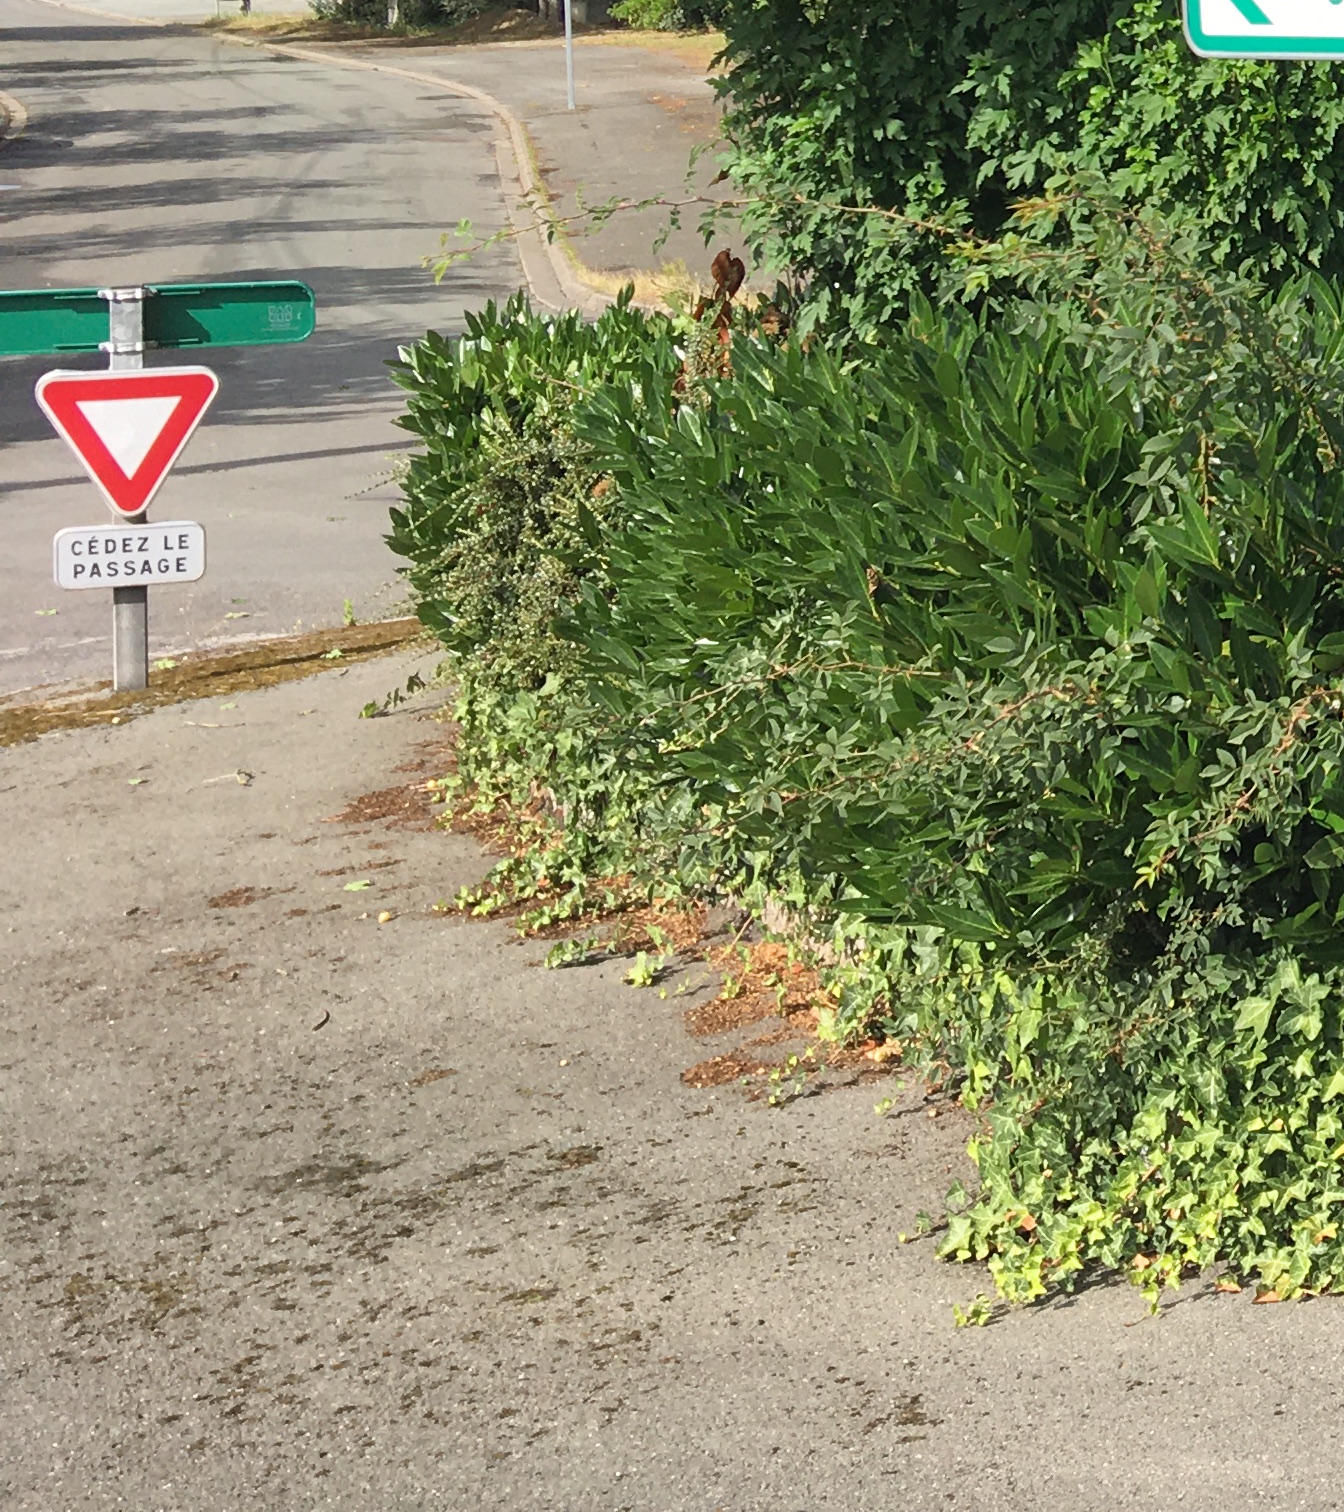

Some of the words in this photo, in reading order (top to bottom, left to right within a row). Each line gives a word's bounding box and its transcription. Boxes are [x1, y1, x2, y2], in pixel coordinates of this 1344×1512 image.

[71, 535, 149, 556] CÉDEZ
[163, 534, 190, 551] LE
[73, 557, 187, 579] PASSAGE
